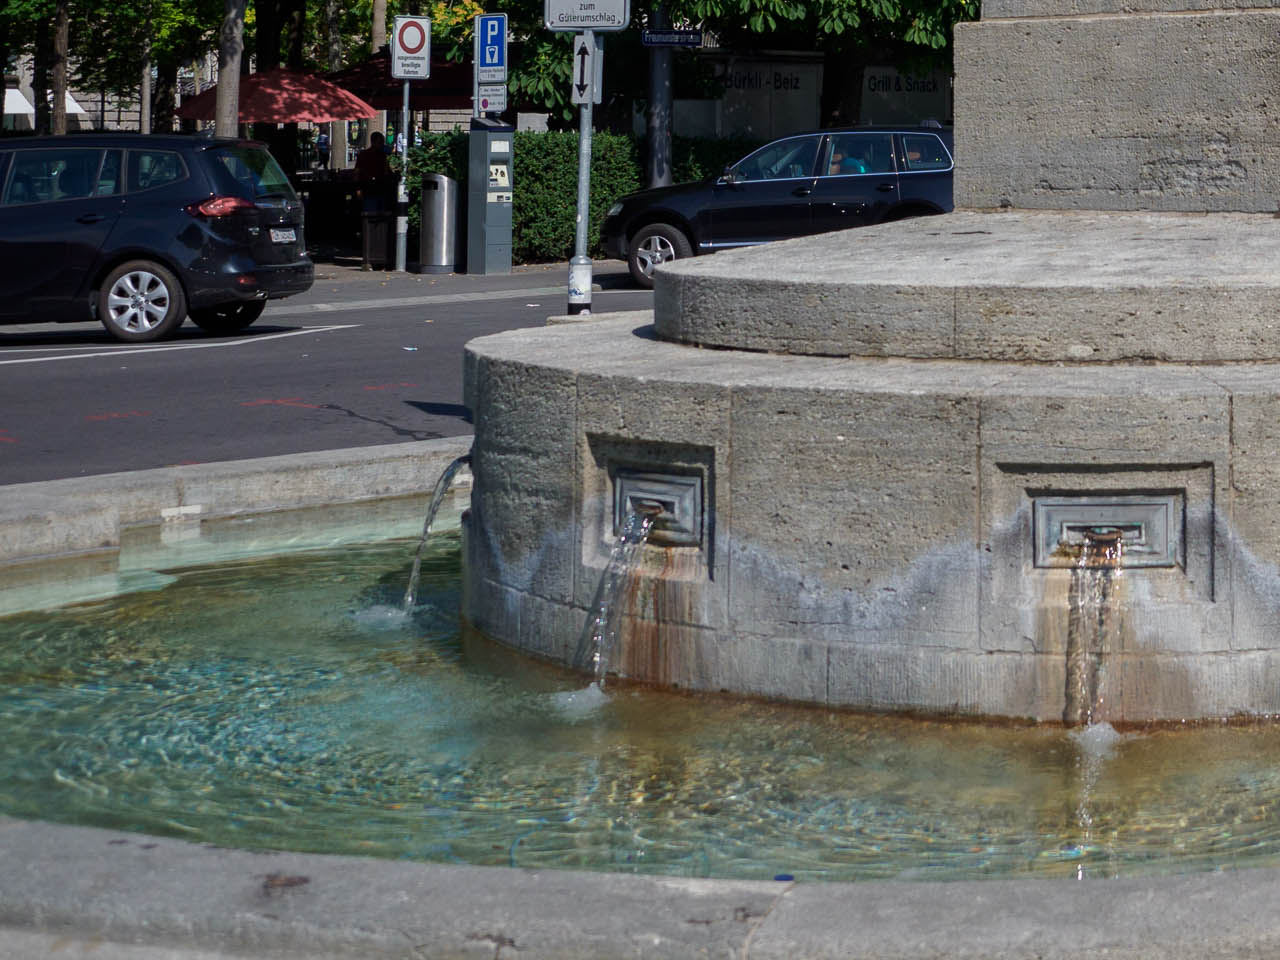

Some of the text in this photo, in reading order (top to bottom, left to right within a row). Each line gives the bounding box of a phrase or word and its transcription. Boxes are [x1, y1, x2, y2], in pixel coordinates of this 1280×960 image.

[579, 3, 596, 11] zum
[558, 12, 616, 24] Güterumschlag
[488, 21, 499, 45] P
[774, 73, 800, 89] Beiz
[868, 76, 938, 93] Grill & Snack
